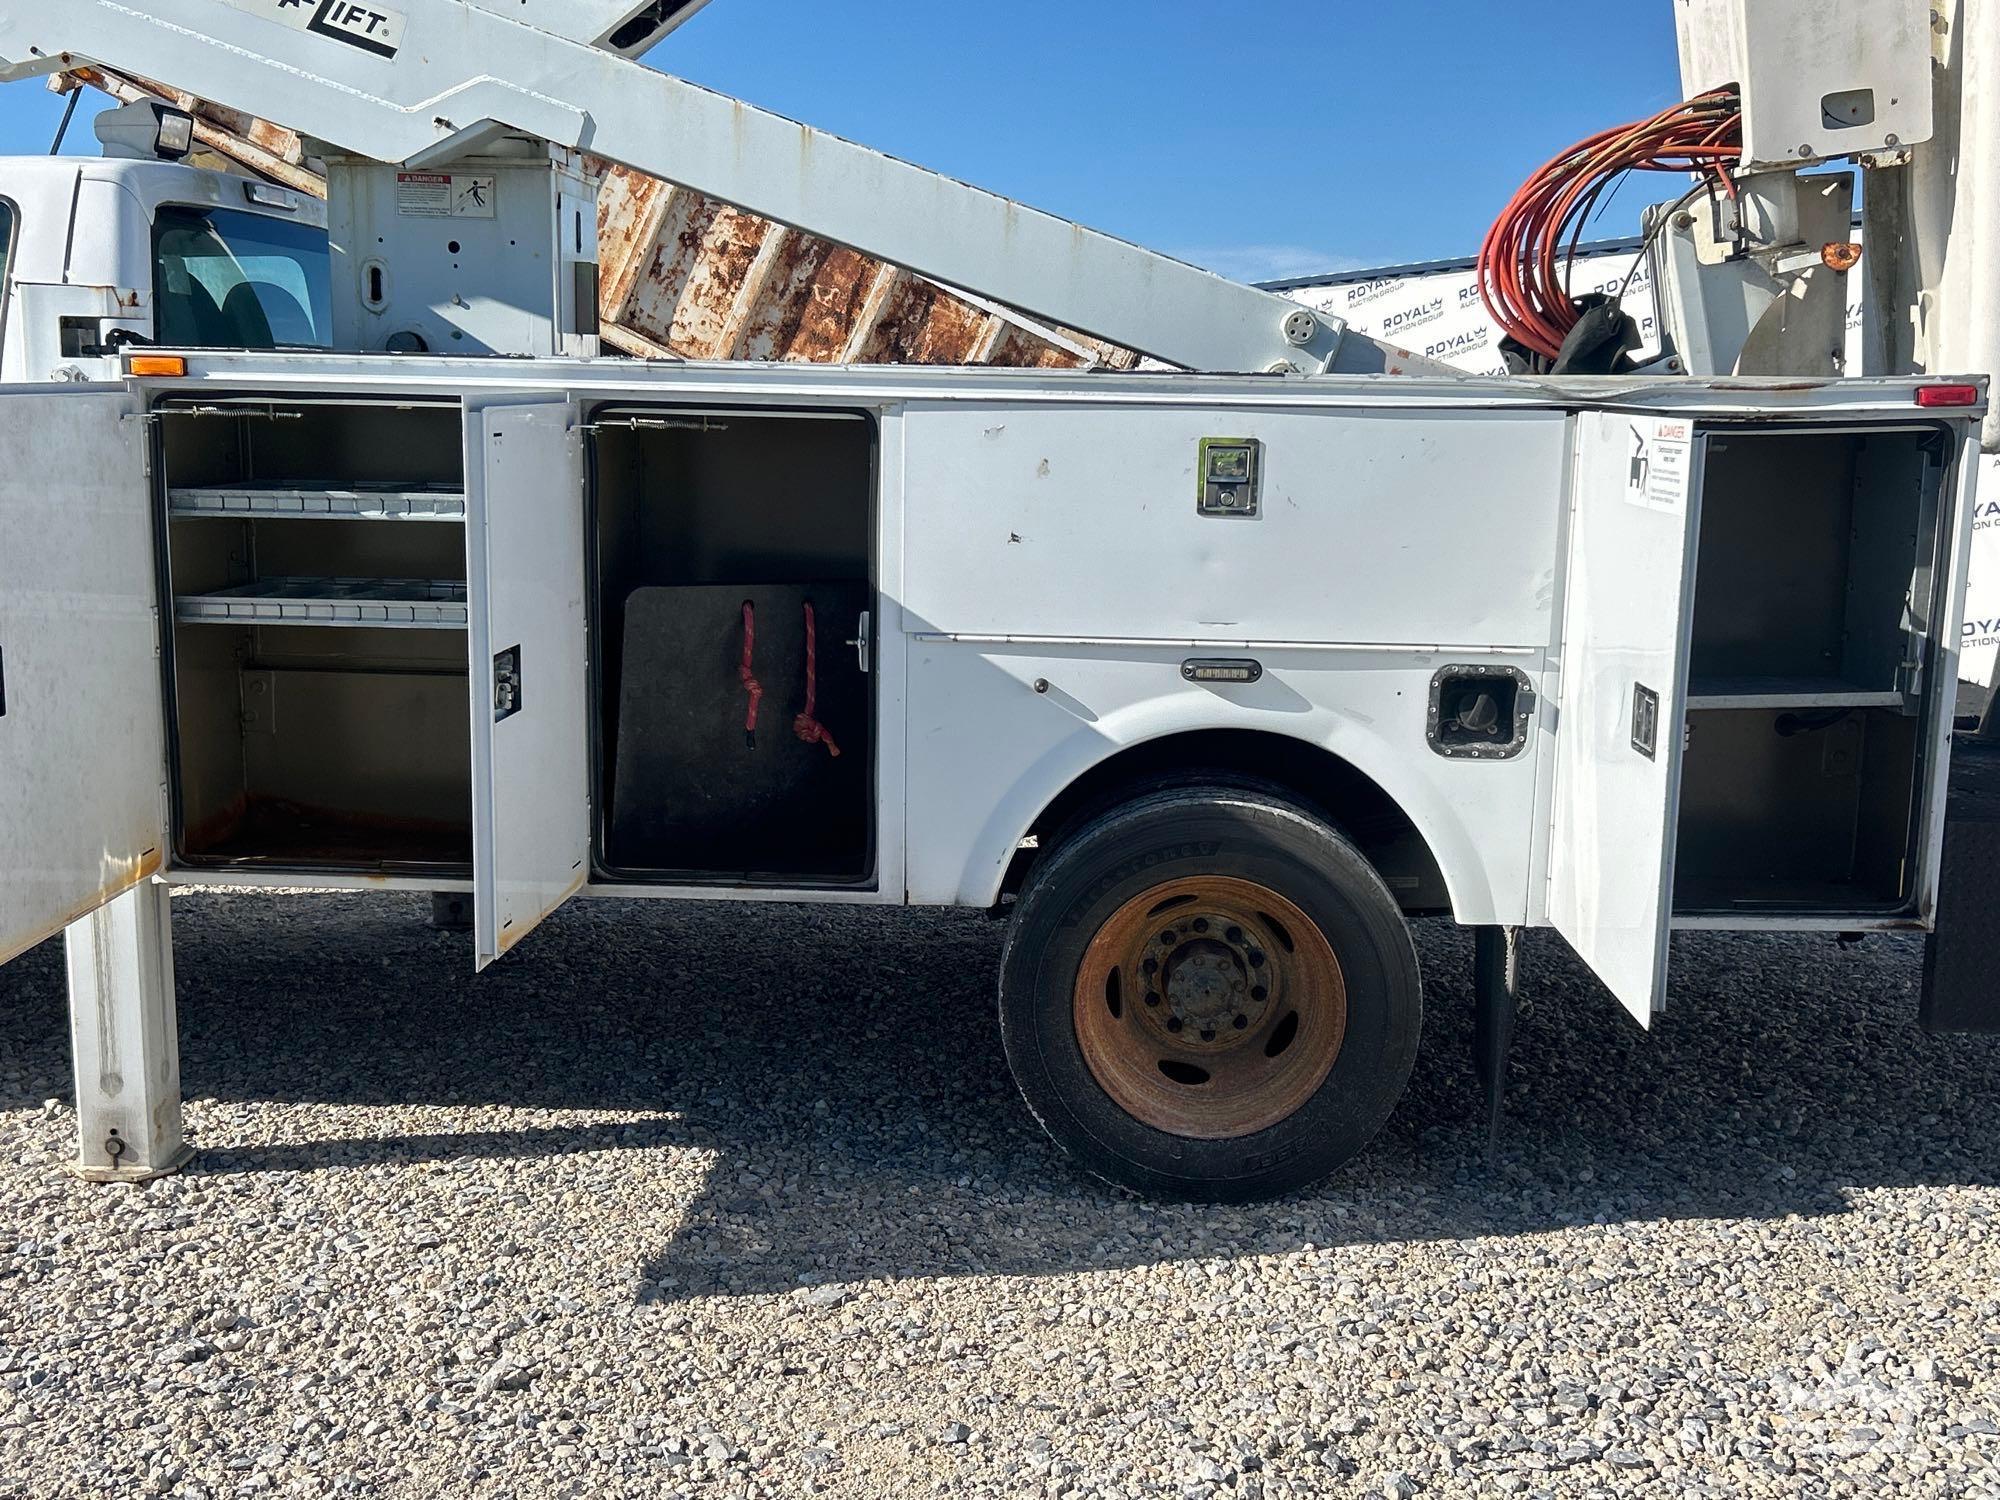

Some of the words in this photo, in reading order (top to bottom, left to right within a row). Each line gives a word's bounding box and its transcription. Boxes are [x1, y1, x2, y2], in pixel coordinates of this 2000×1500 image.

[411, 175, 444, 183] DANGER
[1348, 292, 1379, 309] AUCTION
[1379, 282, 1405, 297] GROUP
[1383, 304, 1430, 329] ROYAL
[1384, 321, 1417, 338] AUCTION
[1418, 311, 1444, 326] GROUP
[1425, 332, 1474, 357] ROYAL
[1461, 339, 1488, 354] GROUP
